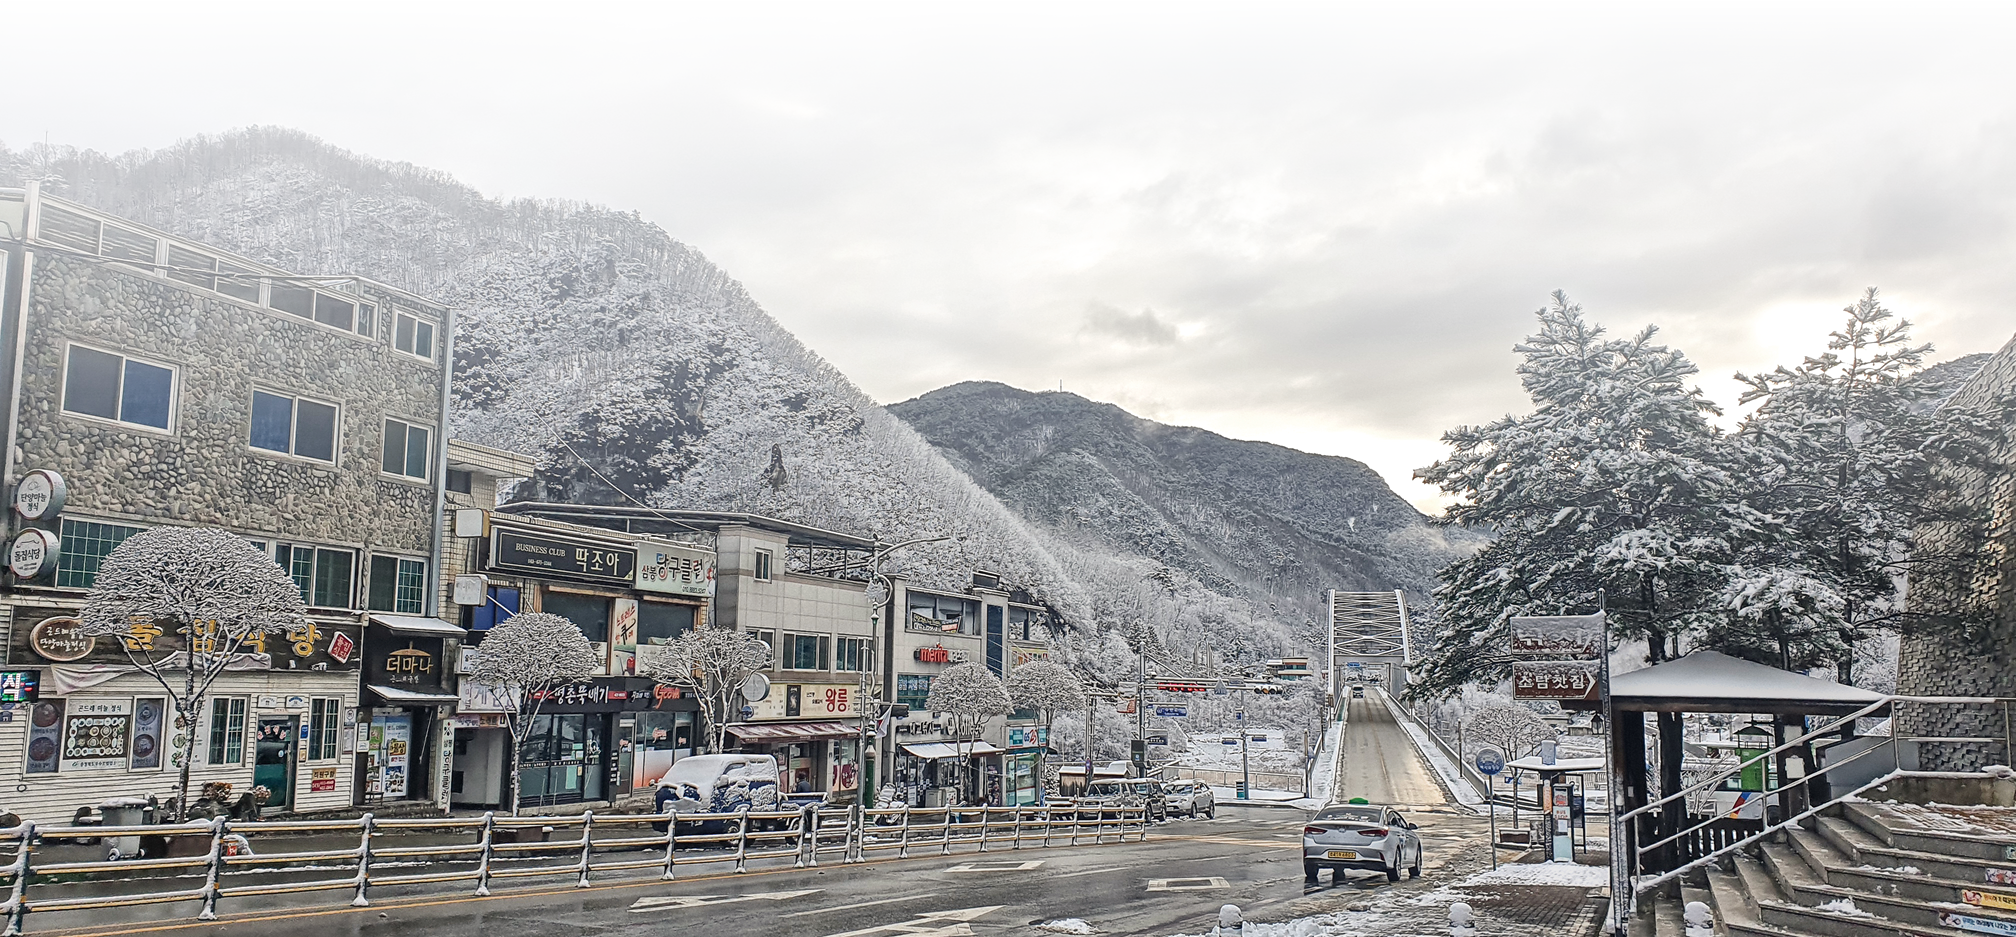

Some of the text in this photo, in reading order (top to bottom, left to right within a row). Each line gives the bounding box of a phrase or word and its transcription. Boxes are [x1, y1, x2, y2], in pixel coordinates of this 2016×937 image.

[21, 493, 47, 502] 단양마늘
[27, 502, 39, 511] 정식
[14, 548, 40, 562] 돌집식당
[515, 543, 565, 556] BUSINESS CLUB
[575, 548, 619, 575] 딱조아
[642, 552, 703, 581] 삼봉 당구클럽
[40, 638, 86, 652] 단양마늘정식
[127, 616, 322, 657] 돌집식당
[386, 655, 433, 674] 더마나
[2, 672, 20, 701] 식
[825, 688, 848, 712] 왕릉
